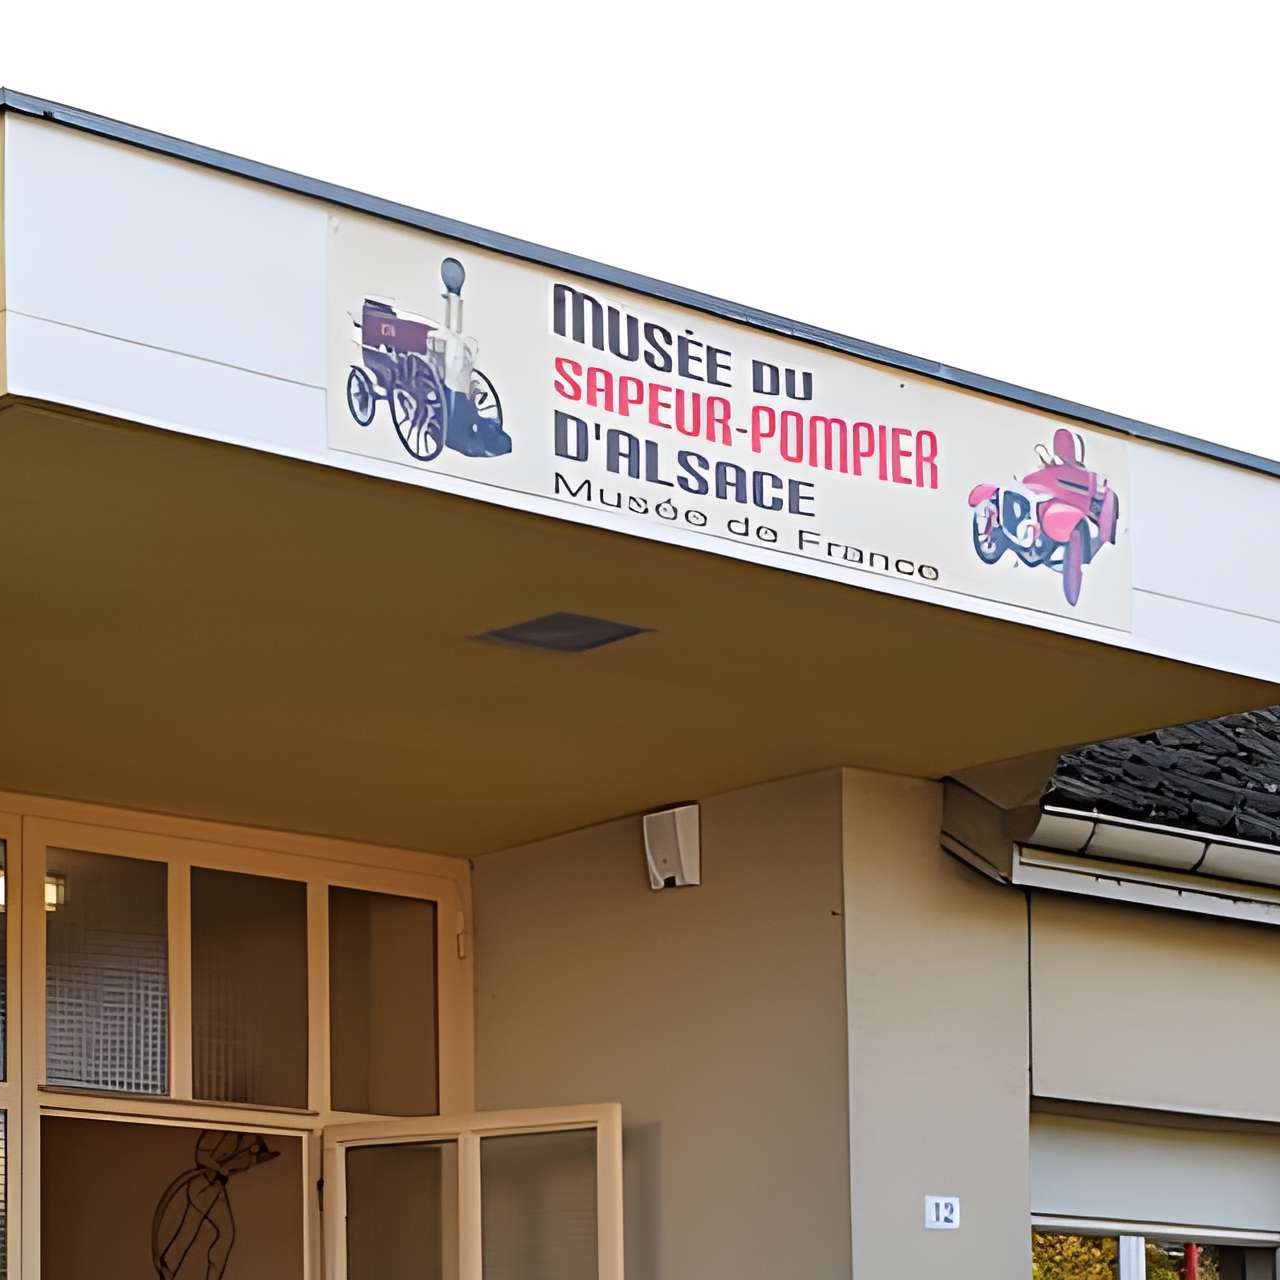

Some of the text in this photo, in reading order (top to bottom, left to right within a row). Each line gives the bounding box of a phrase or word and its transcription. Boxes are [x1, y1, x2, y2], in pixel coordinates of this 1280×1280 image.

[554, 283, 813, 401] MUSÉE DU
[554, 356, 939, 490] SAPEUR-POMPIER
[554, 409, 816, 518] D'ALSACE
[934, 1201, 954, 1224] 12
